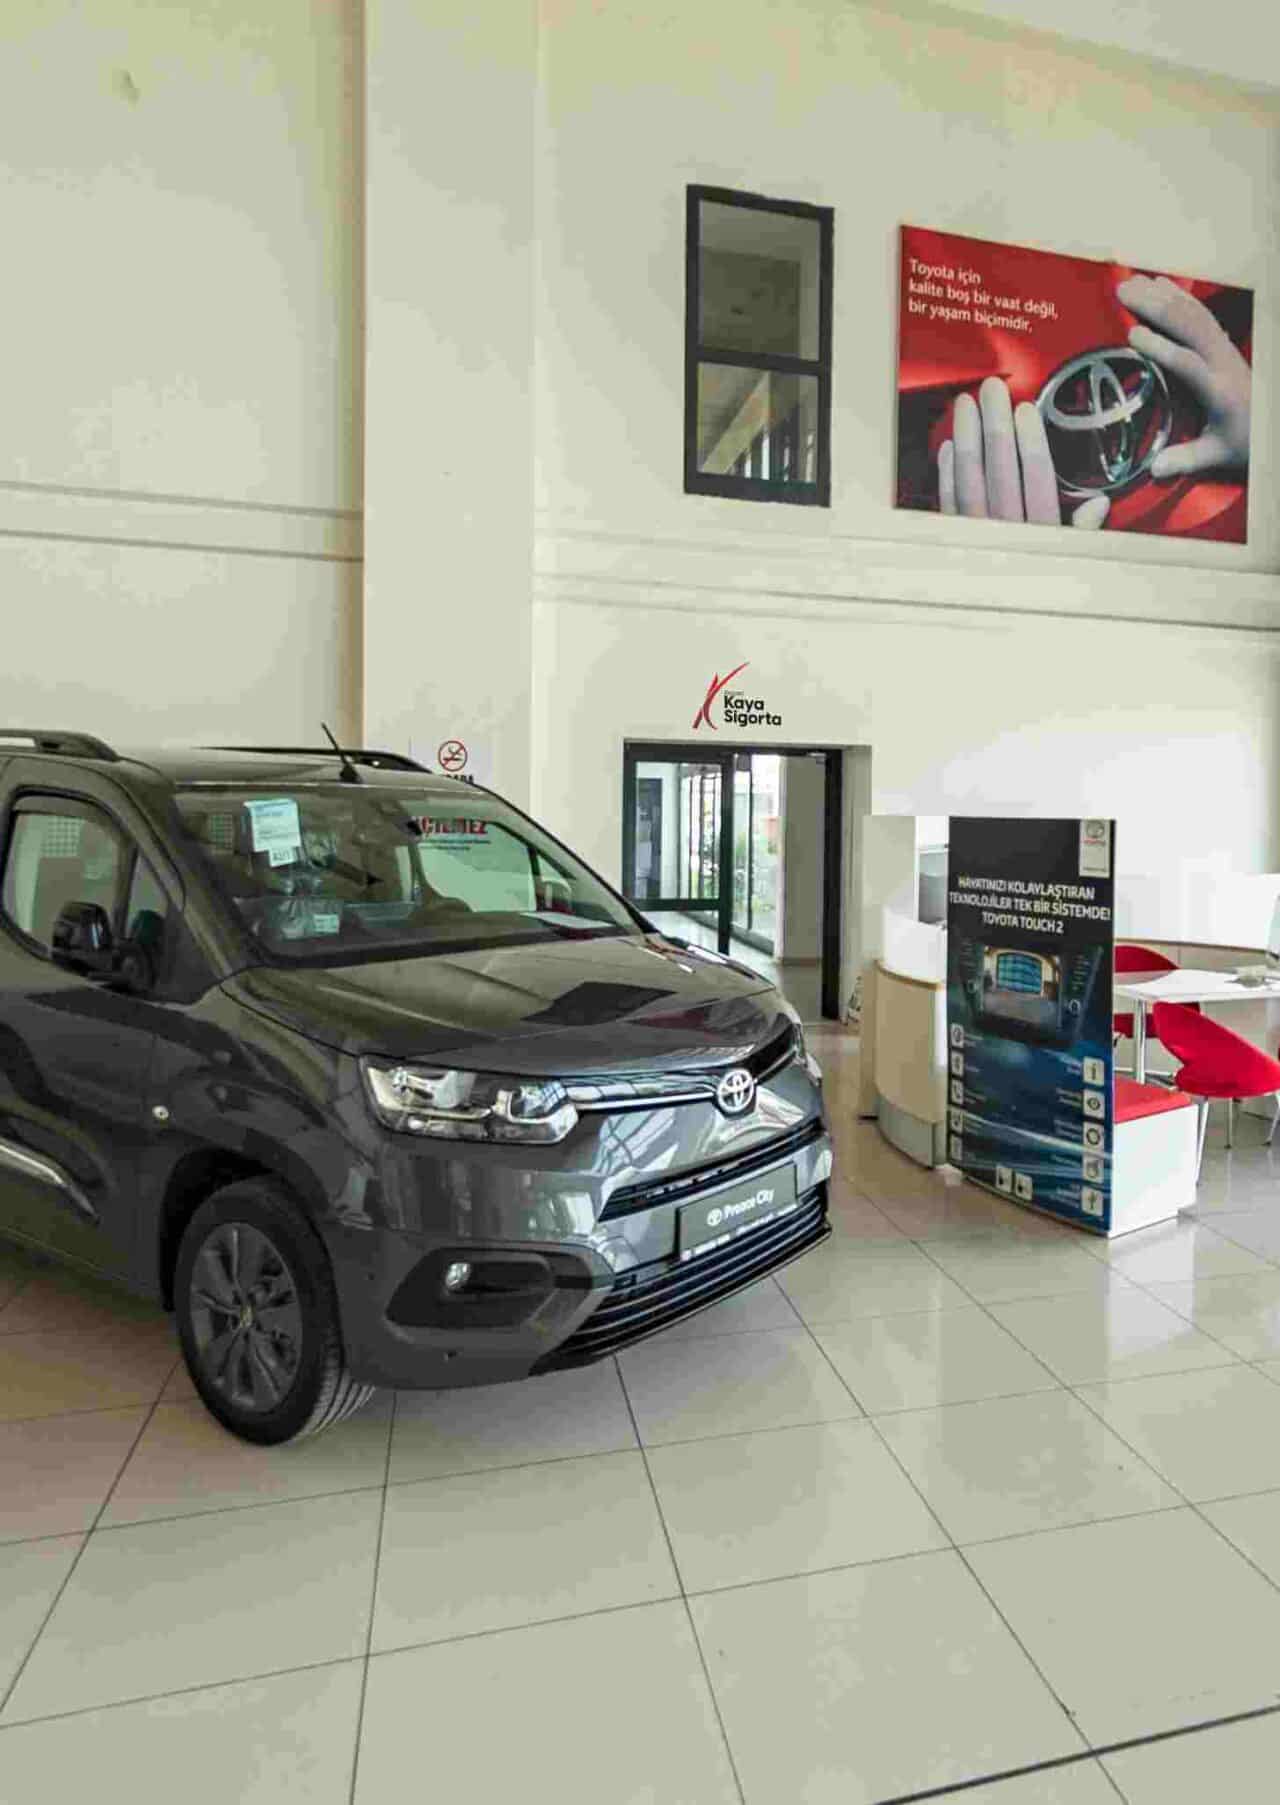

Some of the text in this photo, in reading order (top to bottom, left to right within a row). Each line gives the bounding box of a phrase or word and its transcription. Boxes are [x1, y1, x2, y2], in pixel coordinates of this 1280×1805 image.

[909, 258, 982, 285] Toyota için
[908, 278, 944, 298] kalite
[947, 287, 970, 305] boş
[973, 290, 992, 306] bir
[994, 297, 1022, 310] vaat
[908, 297, 927, 313] bir
[929, 304, 972, 322] yaşam
[723, 695, 765, 713] Kaya
[723, 709, 782, 727] Sigorta
[1007, 880, 1096, 900] KOLAYLAŞTIRAN
[1013, 898, 1032, 911] TEK
[1033, 898, 1050, 914] BİR
[982, 911, 1064, 934] TOYOTA TOUCH 2
